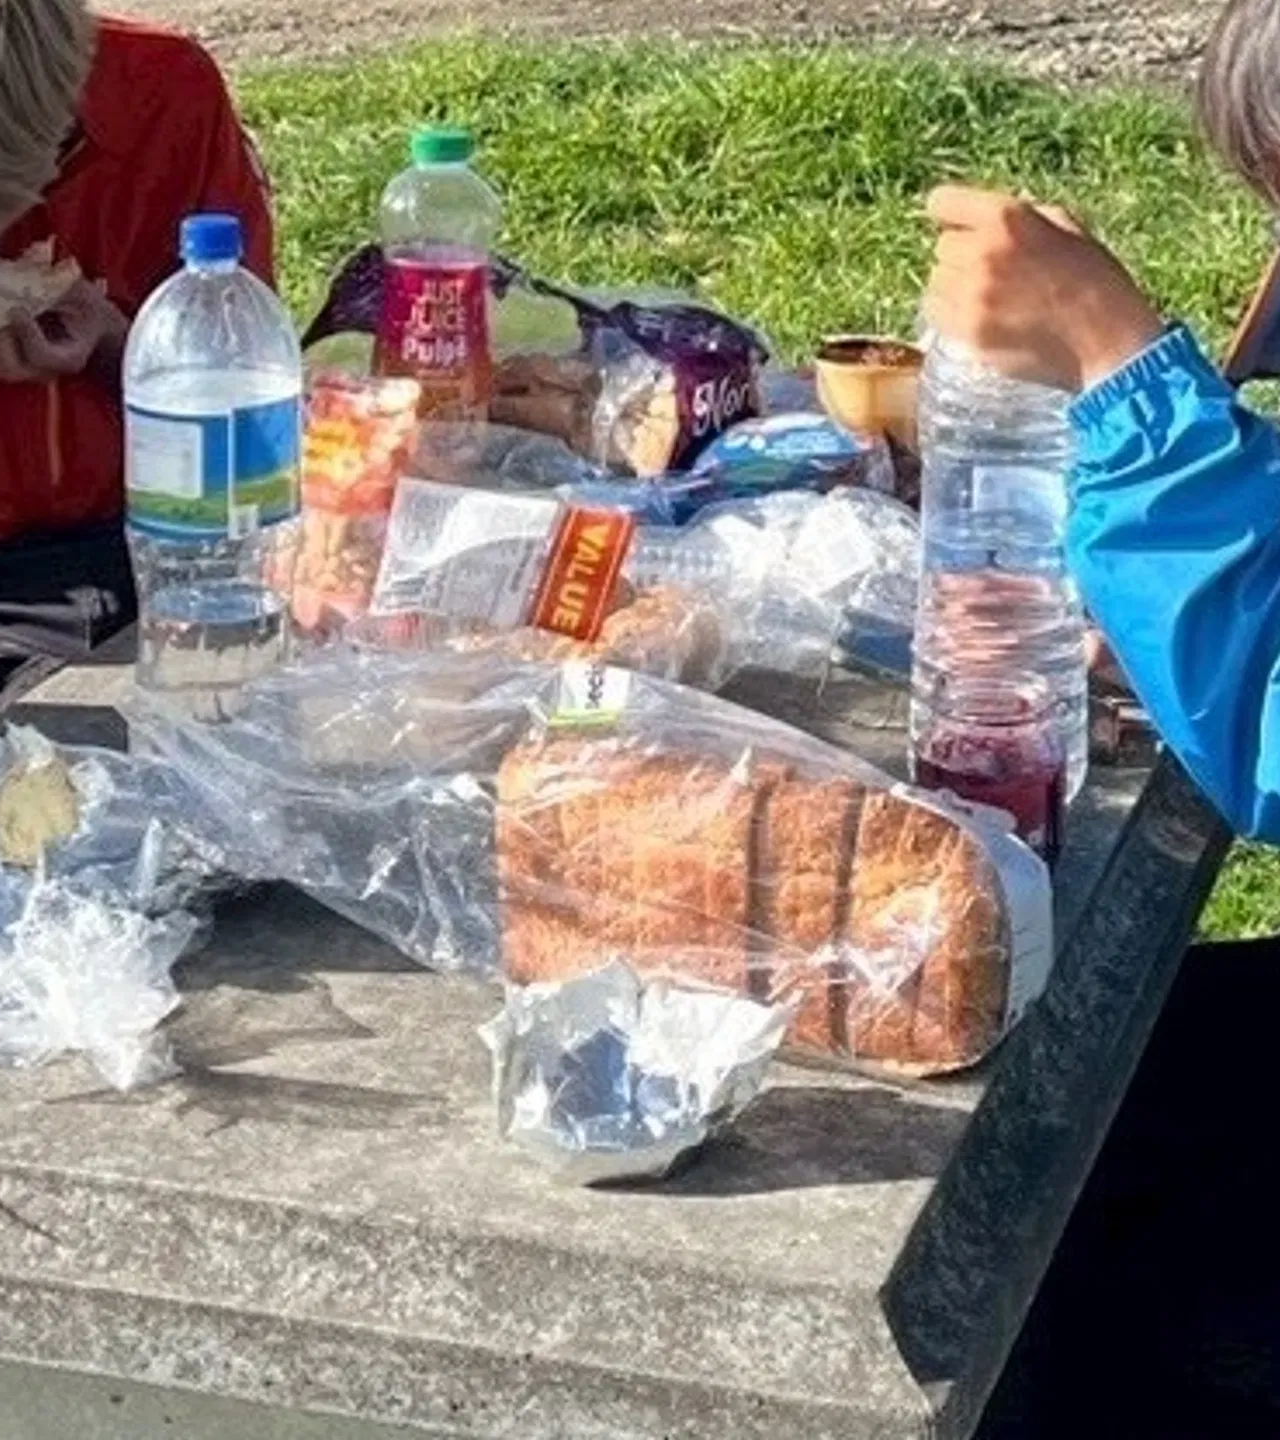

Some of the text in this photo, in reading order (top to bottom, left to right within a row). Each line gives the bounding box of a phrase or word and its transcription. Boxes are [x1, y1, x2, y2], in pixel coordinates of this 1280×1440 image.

[415, 278, 466, 303] JUST
[403, 303, 468, 332] JUICE
[552, 521, 614, 633] VALUE
